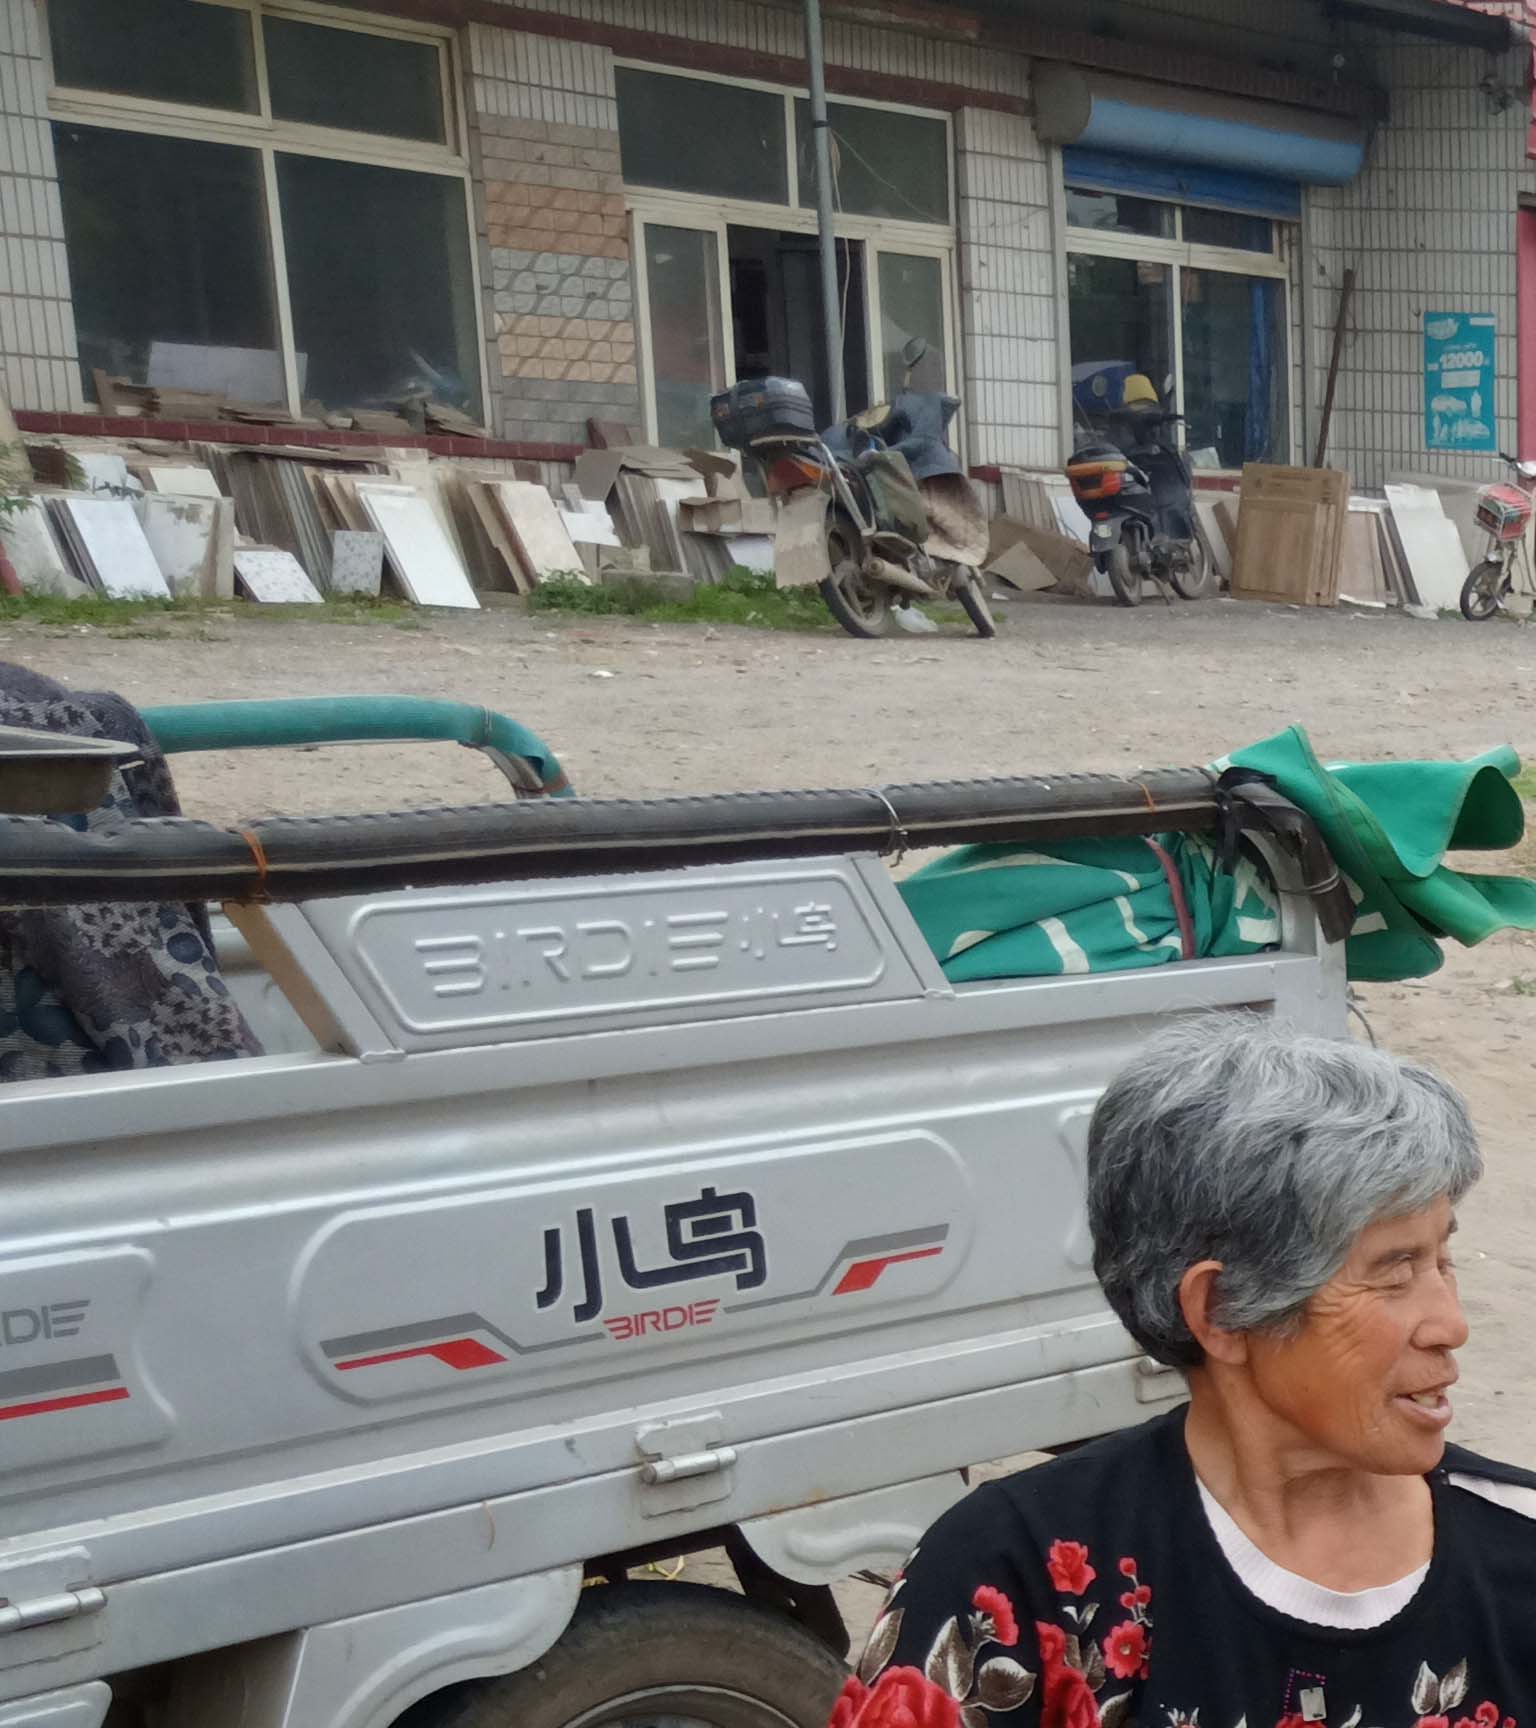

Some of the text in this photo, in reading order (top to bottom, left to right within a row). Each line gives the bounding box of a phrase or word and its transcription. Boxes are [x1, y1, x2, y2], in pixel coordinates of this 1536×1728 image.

[415, 911, 728, 996] BIRDIE
[536, 1187, 767, 1323] 小鸟
[603, 1298, 721, 1340] BIRDIE
